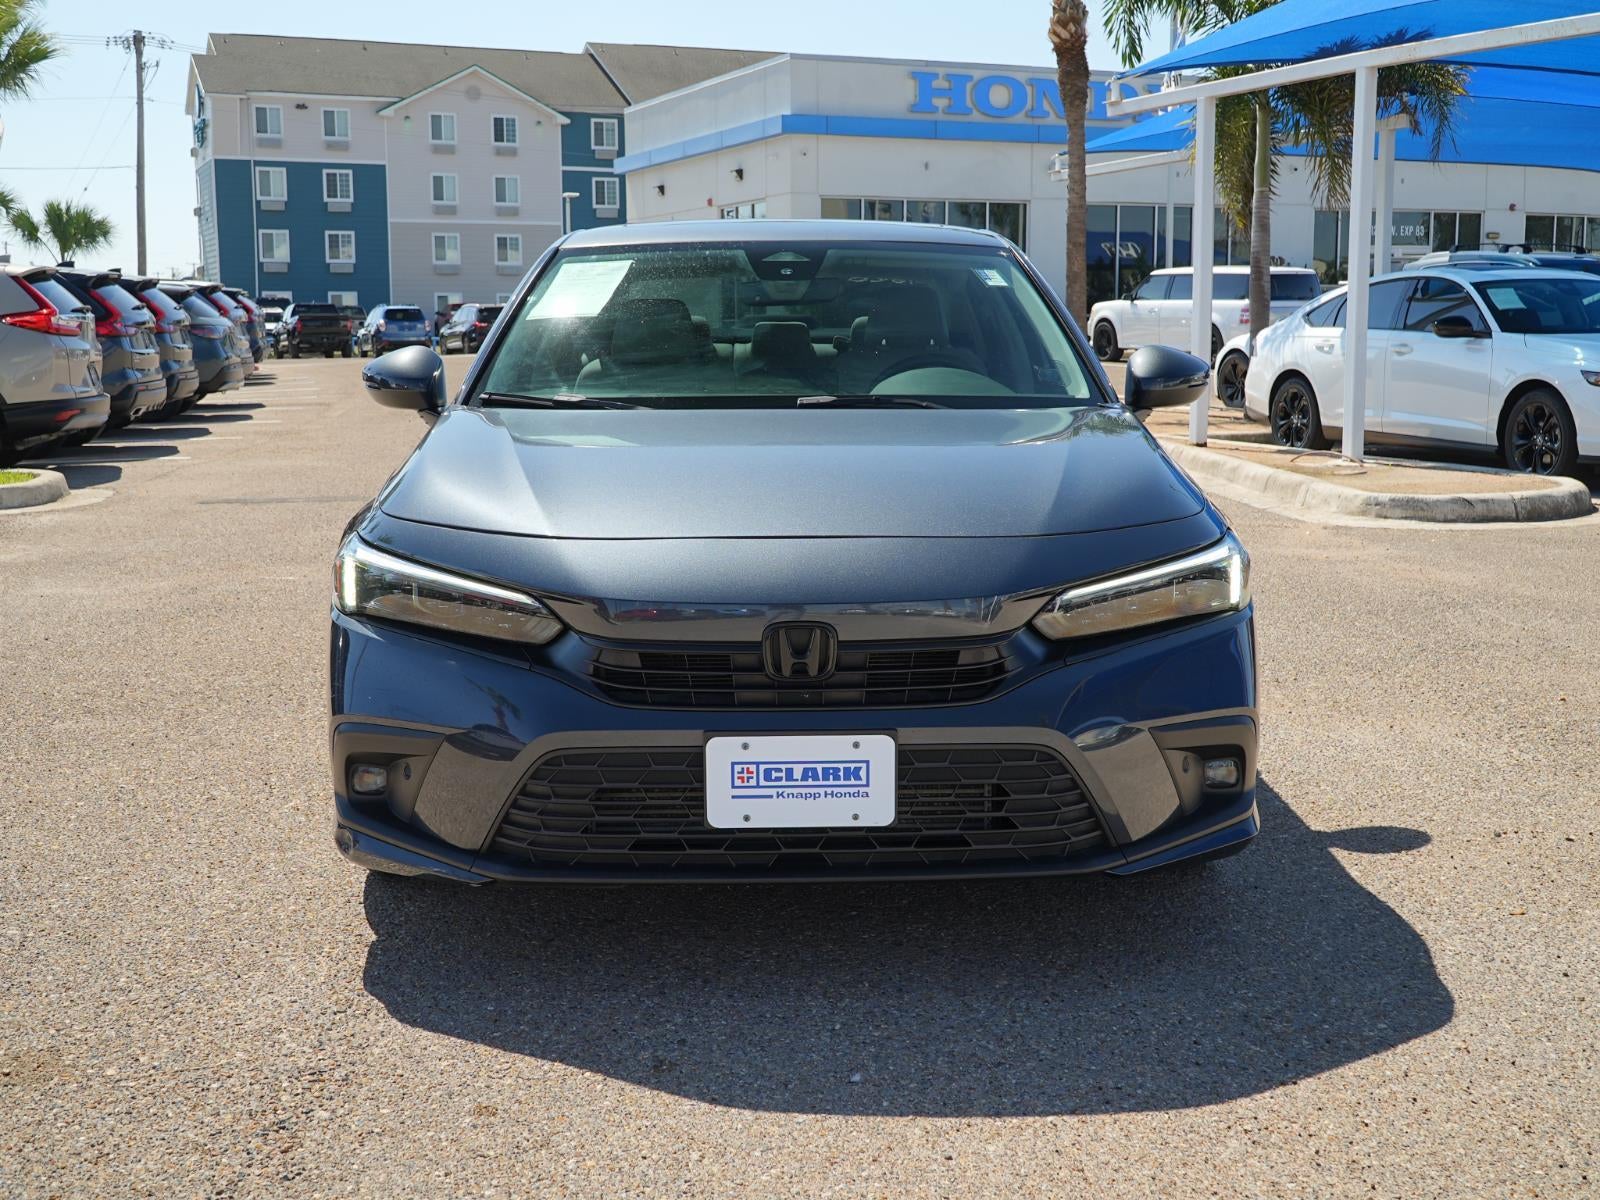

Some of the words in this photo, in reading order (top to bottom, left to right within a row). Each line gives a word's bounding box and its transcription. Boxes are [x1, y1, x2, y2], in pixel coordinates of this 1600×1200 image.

[1400, 225, 1414, 236] EXP
[763, 766, 863, 783] CLARK
[776, 790, 821, 800] Knapp
[823, 789, 870, 799] Honda
